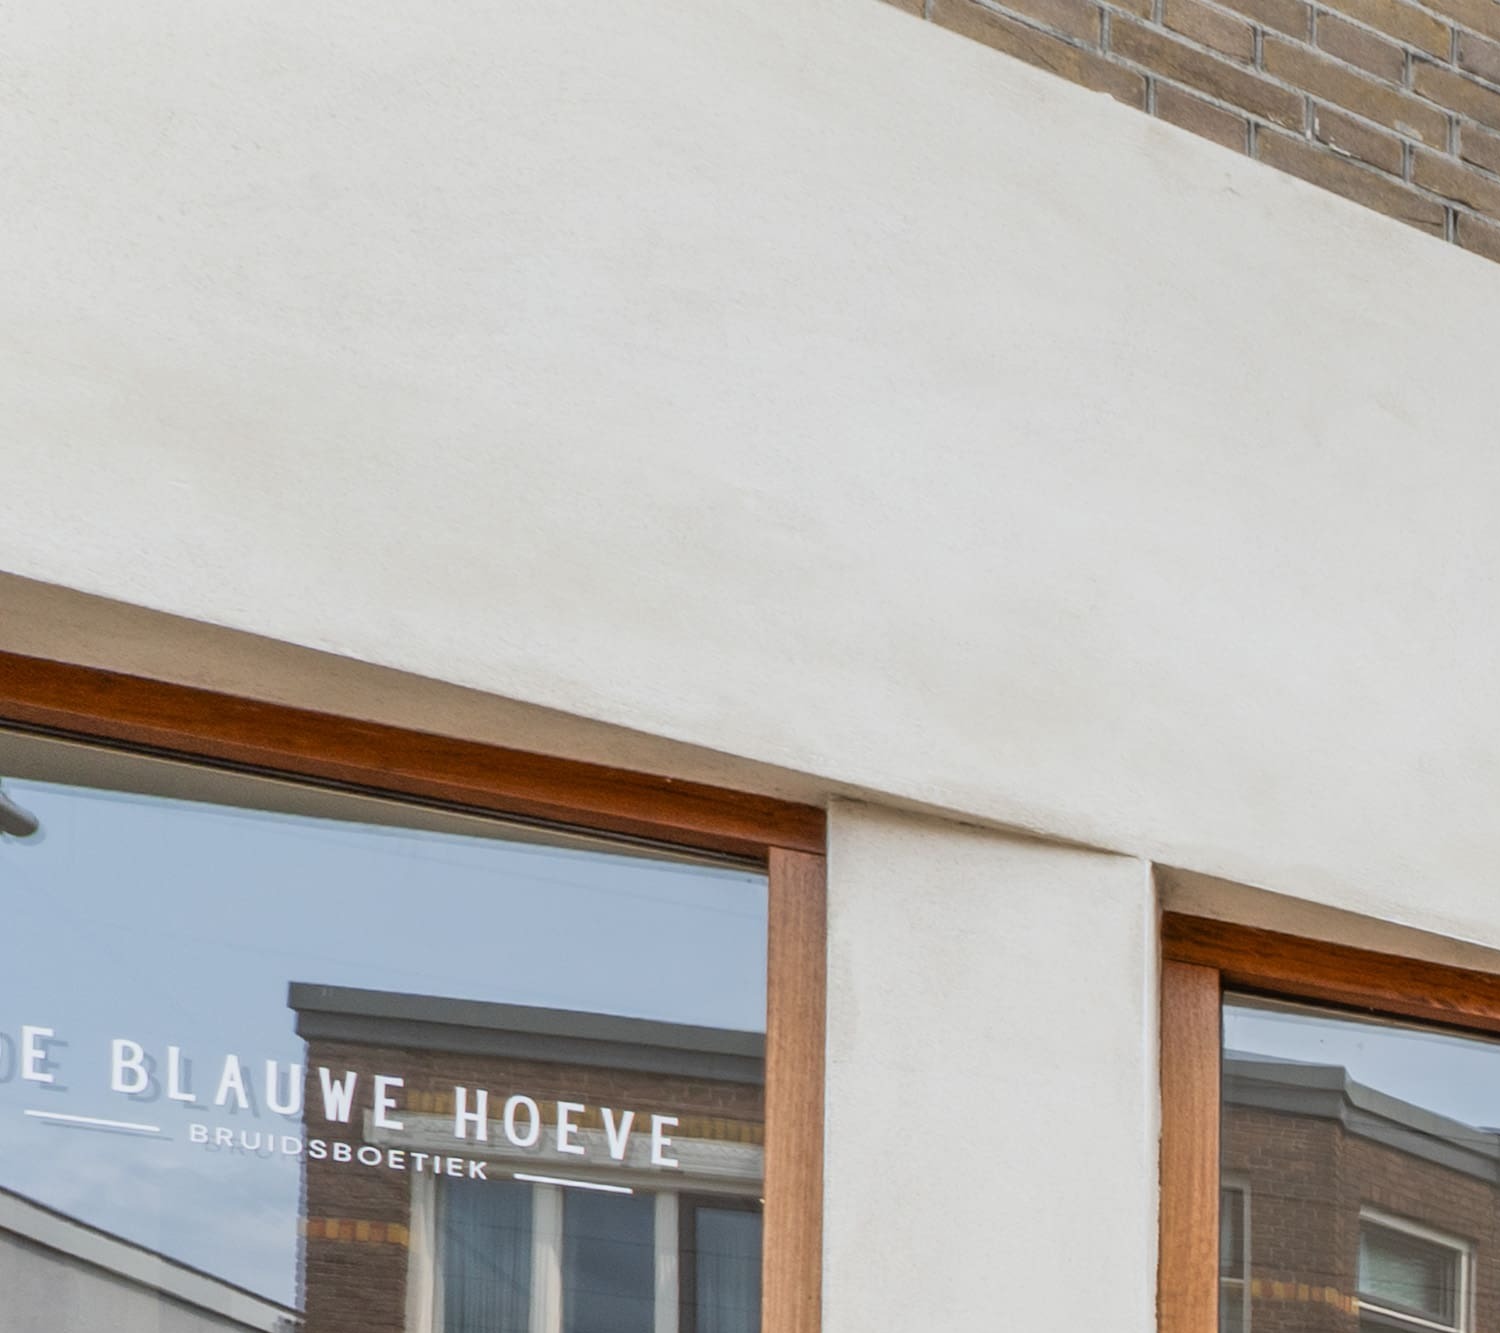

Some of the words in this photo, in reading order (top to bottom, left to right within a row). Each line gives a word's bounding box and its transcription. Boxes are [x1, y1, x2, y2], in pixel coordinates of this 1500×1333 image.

[22, 1025, 54, 1083] E
[111, 1038, 405, 1131] BLAUWE
[454, 1086, 680, 1168] HOEVE
[190, 1123, 488, 1181] BRUIDSBOETIEK
